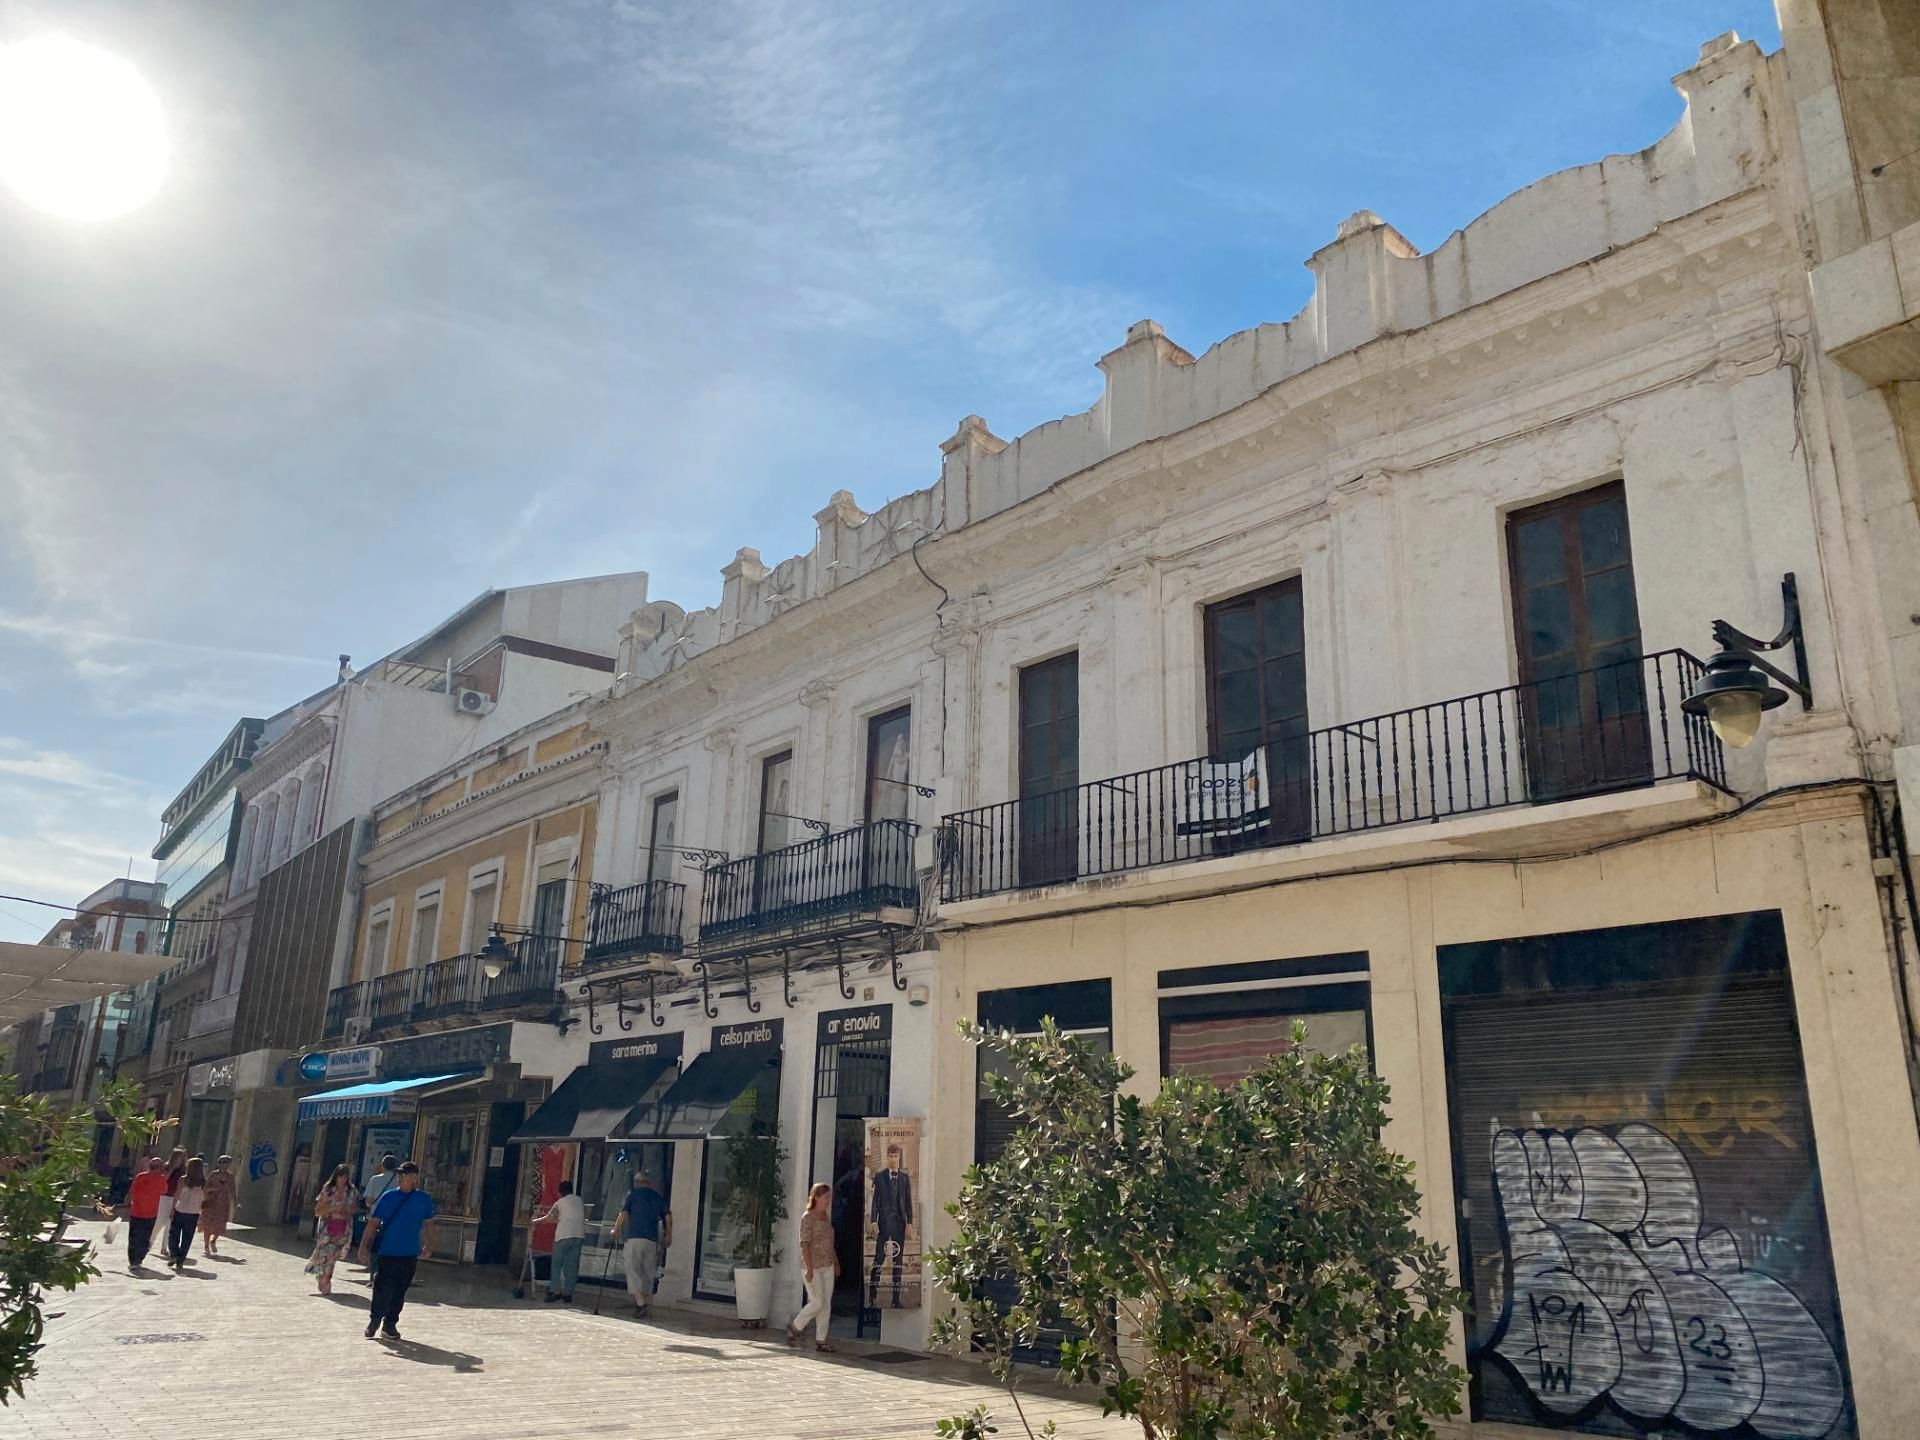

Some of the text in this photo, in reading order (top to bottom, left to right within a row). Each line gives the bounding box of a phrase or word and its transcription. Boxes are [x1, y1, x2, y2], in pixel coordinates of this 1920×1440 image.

[828, 1012, 880, 1034] ar enovia
[720, 1024, 772, 1048] celso prieto
[612, 1041, 658, 1059] sara merino
[1687, 1317, 1732, 1360] 23
